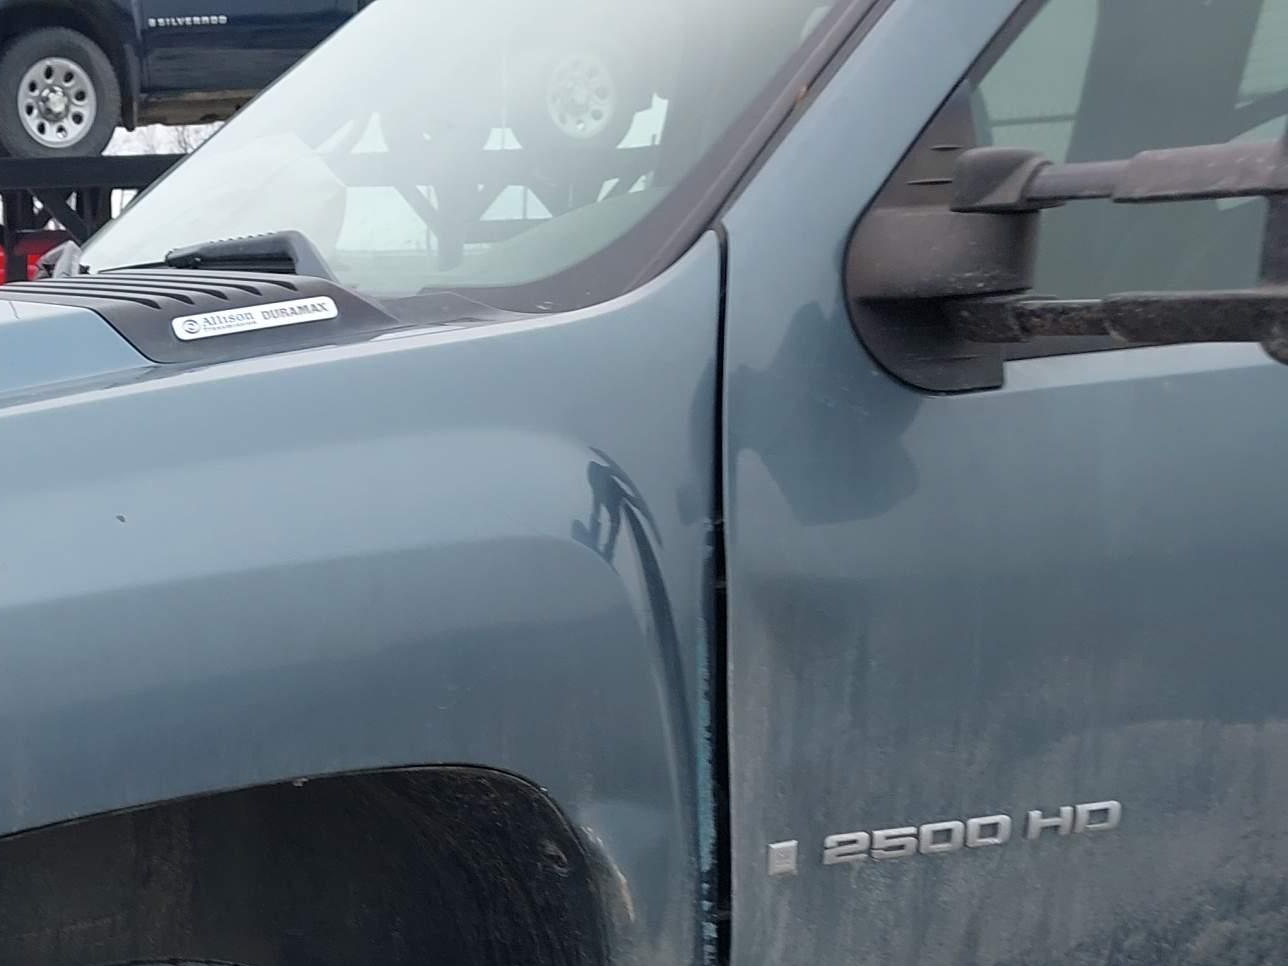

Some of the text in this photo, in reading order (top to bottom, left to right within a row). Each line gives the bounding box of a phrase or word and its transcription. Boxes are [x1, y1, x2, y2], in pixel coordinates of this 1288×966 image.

[202, 312, 254, 326] Allison
[261, 303, 329, 321] DURAMAX
[824, 800, 1122, 865] 2500 HD
